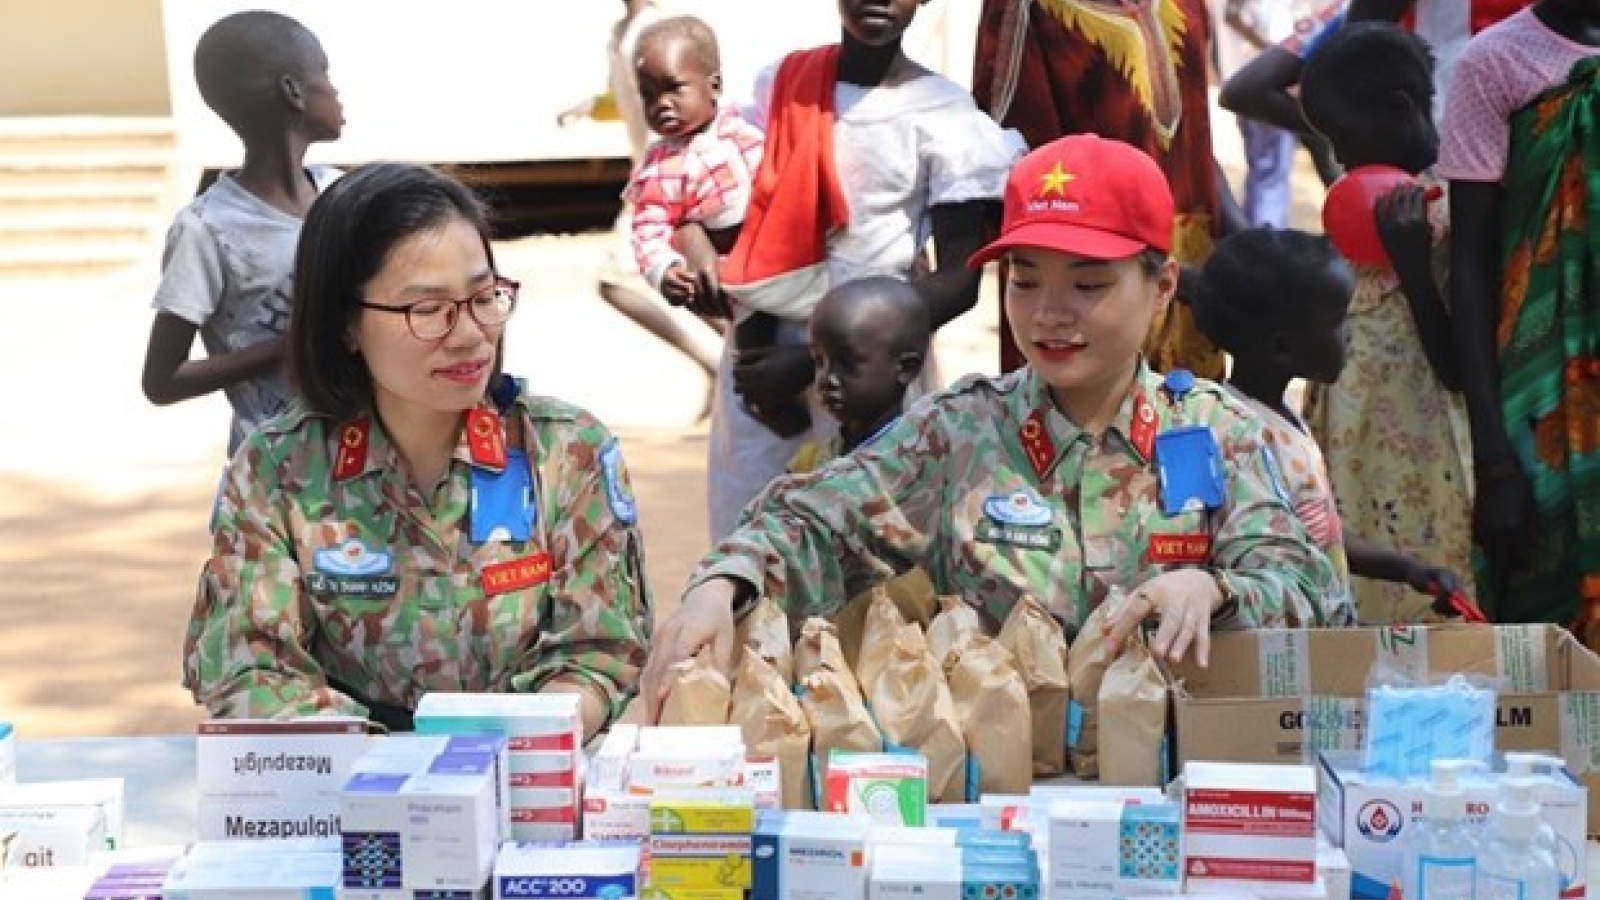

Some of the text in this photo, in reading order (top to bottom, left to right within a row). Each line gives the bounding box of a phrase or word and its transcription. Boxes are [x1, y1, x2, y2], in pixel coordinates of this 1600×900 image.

[1052, 197, 1080, 211] Nam
[1154, 541, 1182, 556] VIET
[487, 560, 549, 587] VIET NAM
[233, 752, 331, 774] Mezapulgit
[505, 878, 586, 895] ACC 200
